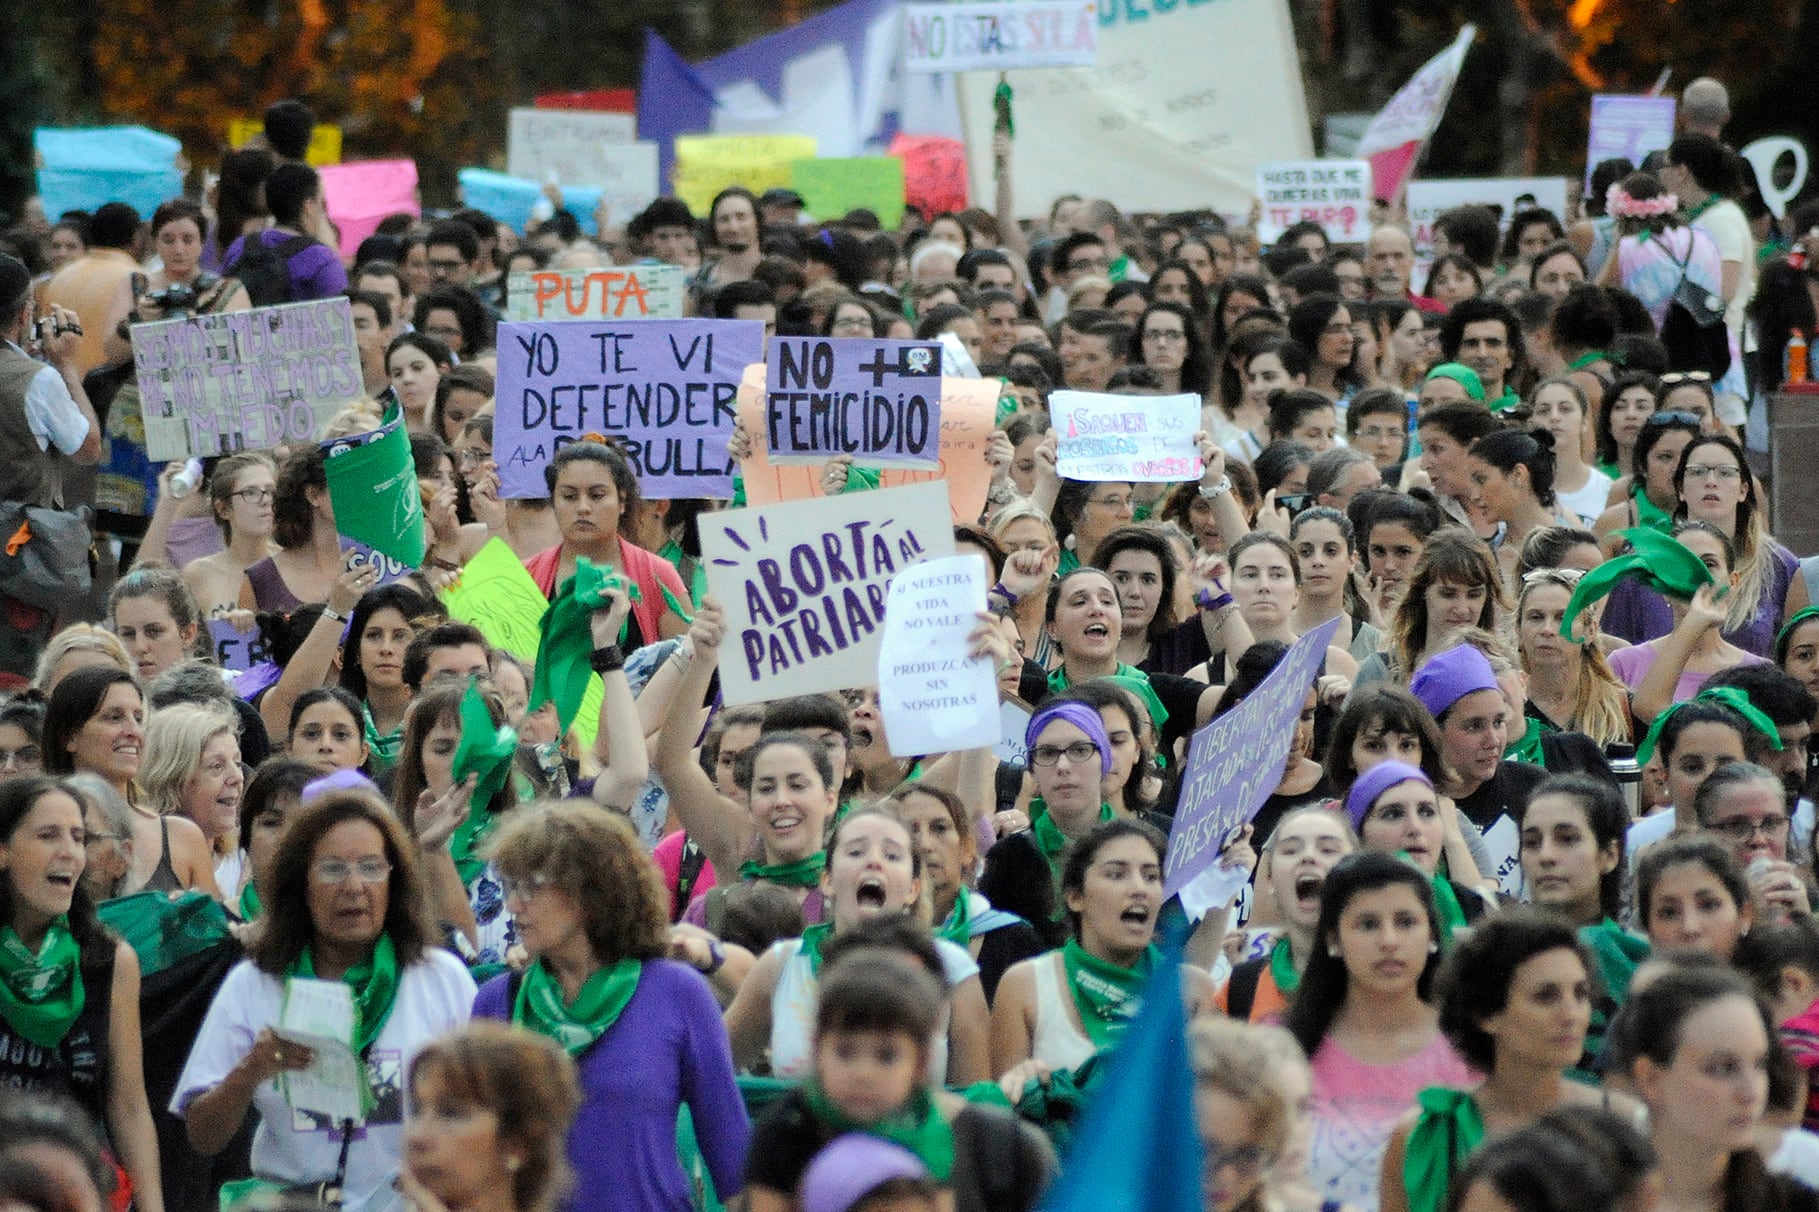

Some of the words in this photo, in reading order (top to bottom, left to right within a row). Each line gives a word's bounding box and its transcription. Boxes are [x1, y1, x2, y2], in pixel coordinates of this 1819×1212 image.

[907, 16, 945, 59] NO
[531, 272, 649, 318] PUTA
[133, 316, 219, 370] SOMOS
[226, 306, 332, 360] MUCHAS
[335, 299, 353, 346] Y
[516, 332, 559, 378] YO
[590, 332, 637, 374] TE
[668, 333, 714, 374] VI
[172, 366, 206, 412] NO
[211, 351, 359, 403] TENEMOS
[779, 341, 834, 390] NO
[522, 382, 738, 431] DEFENDER
[1157, 417, 1184, 431] SUS
[1153, 436, 1177, 453] DE
[745, 518, 896, 627] ABORTÁ
[898, 529, 926, 563] AL
[912, 573, 973, 591] NUESTRA
[904, 618, 924, 631] NO
[927, 613, 963, 628] VALE
[915, 598, 949, 611] VIDA
[741, 579, 893, 682] PATRIAR
[892, 656, 979, 678] PRODUZCAN
[925, 678, 949, 690] SIN
[902, 694, 978, 713] NOSOTRAS
